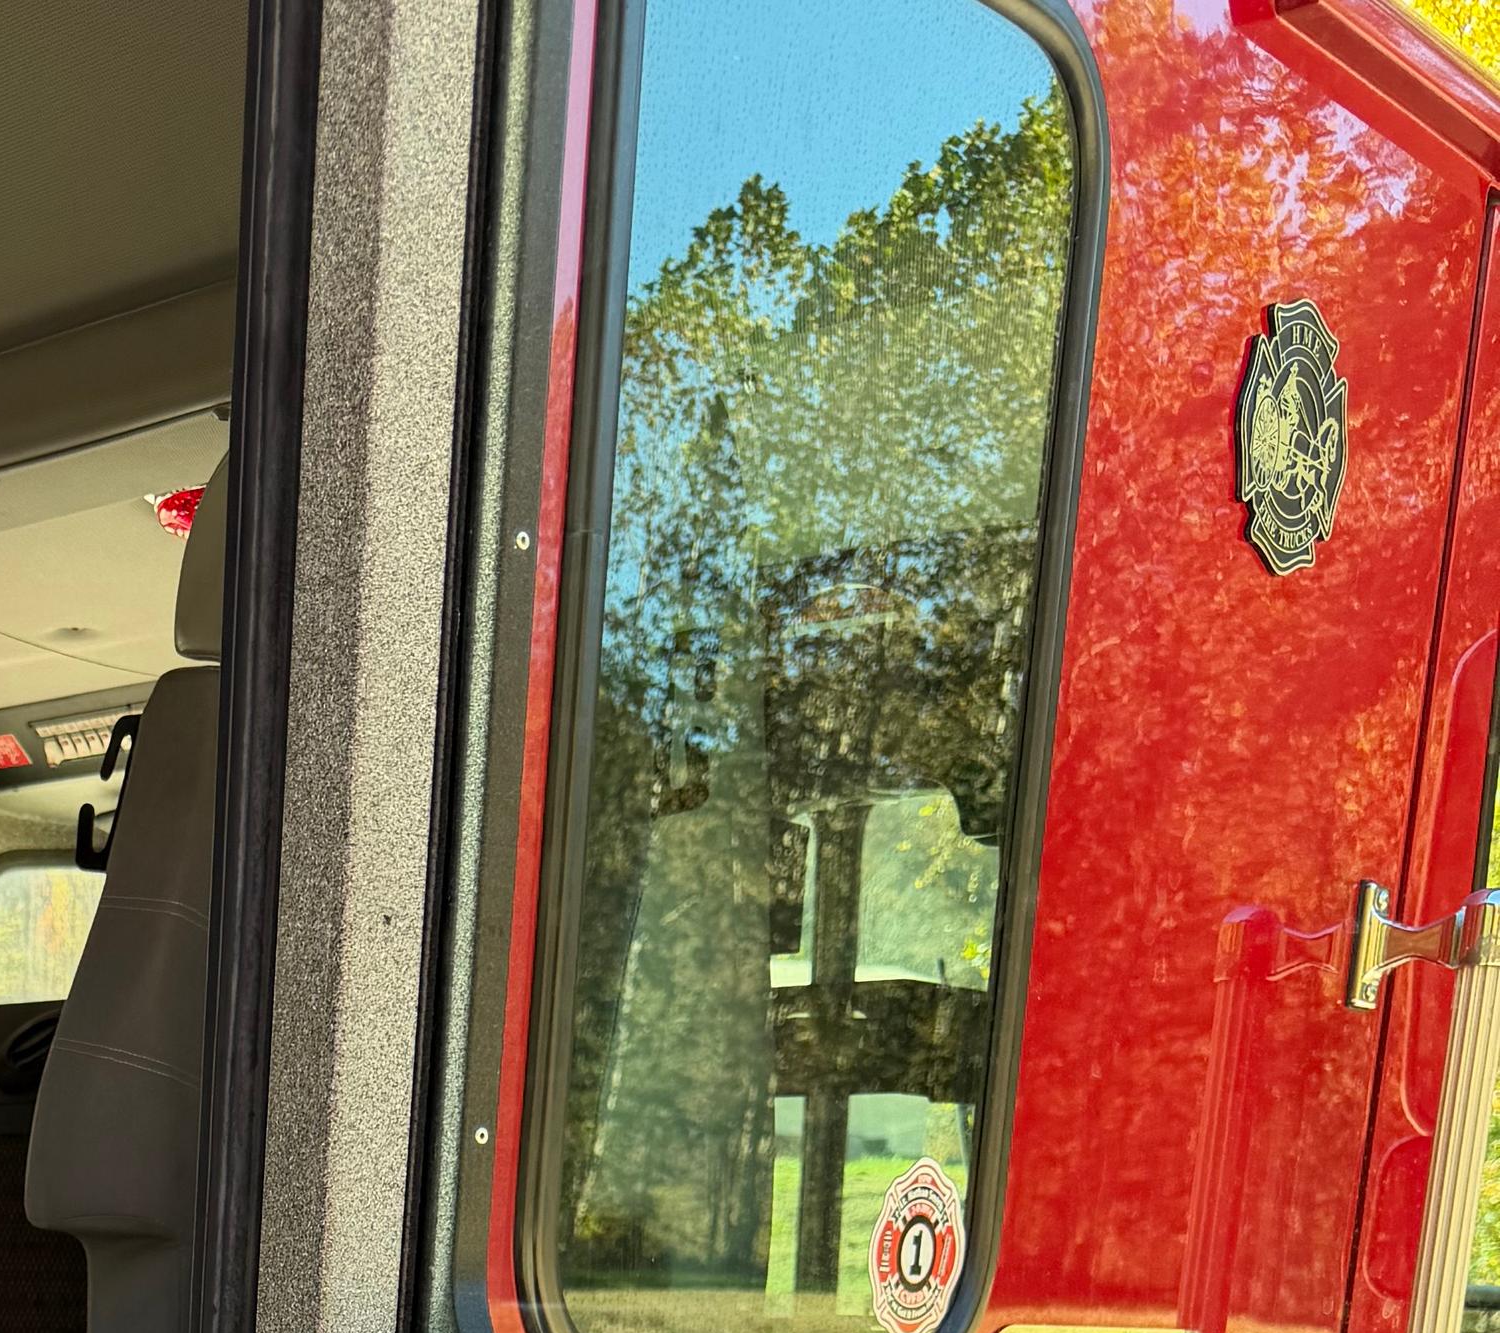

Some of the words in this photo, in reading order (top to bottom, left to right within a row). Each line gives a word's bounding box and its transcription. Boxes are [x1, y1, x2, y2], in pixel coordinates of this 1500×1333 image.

[1291, 325, 1321, 358] HME
[1258, 499, 1277, 540] FIRE
[1278, 523, 1313, 549] TRUCKS
[909, 1230, 924, 1276] 1
